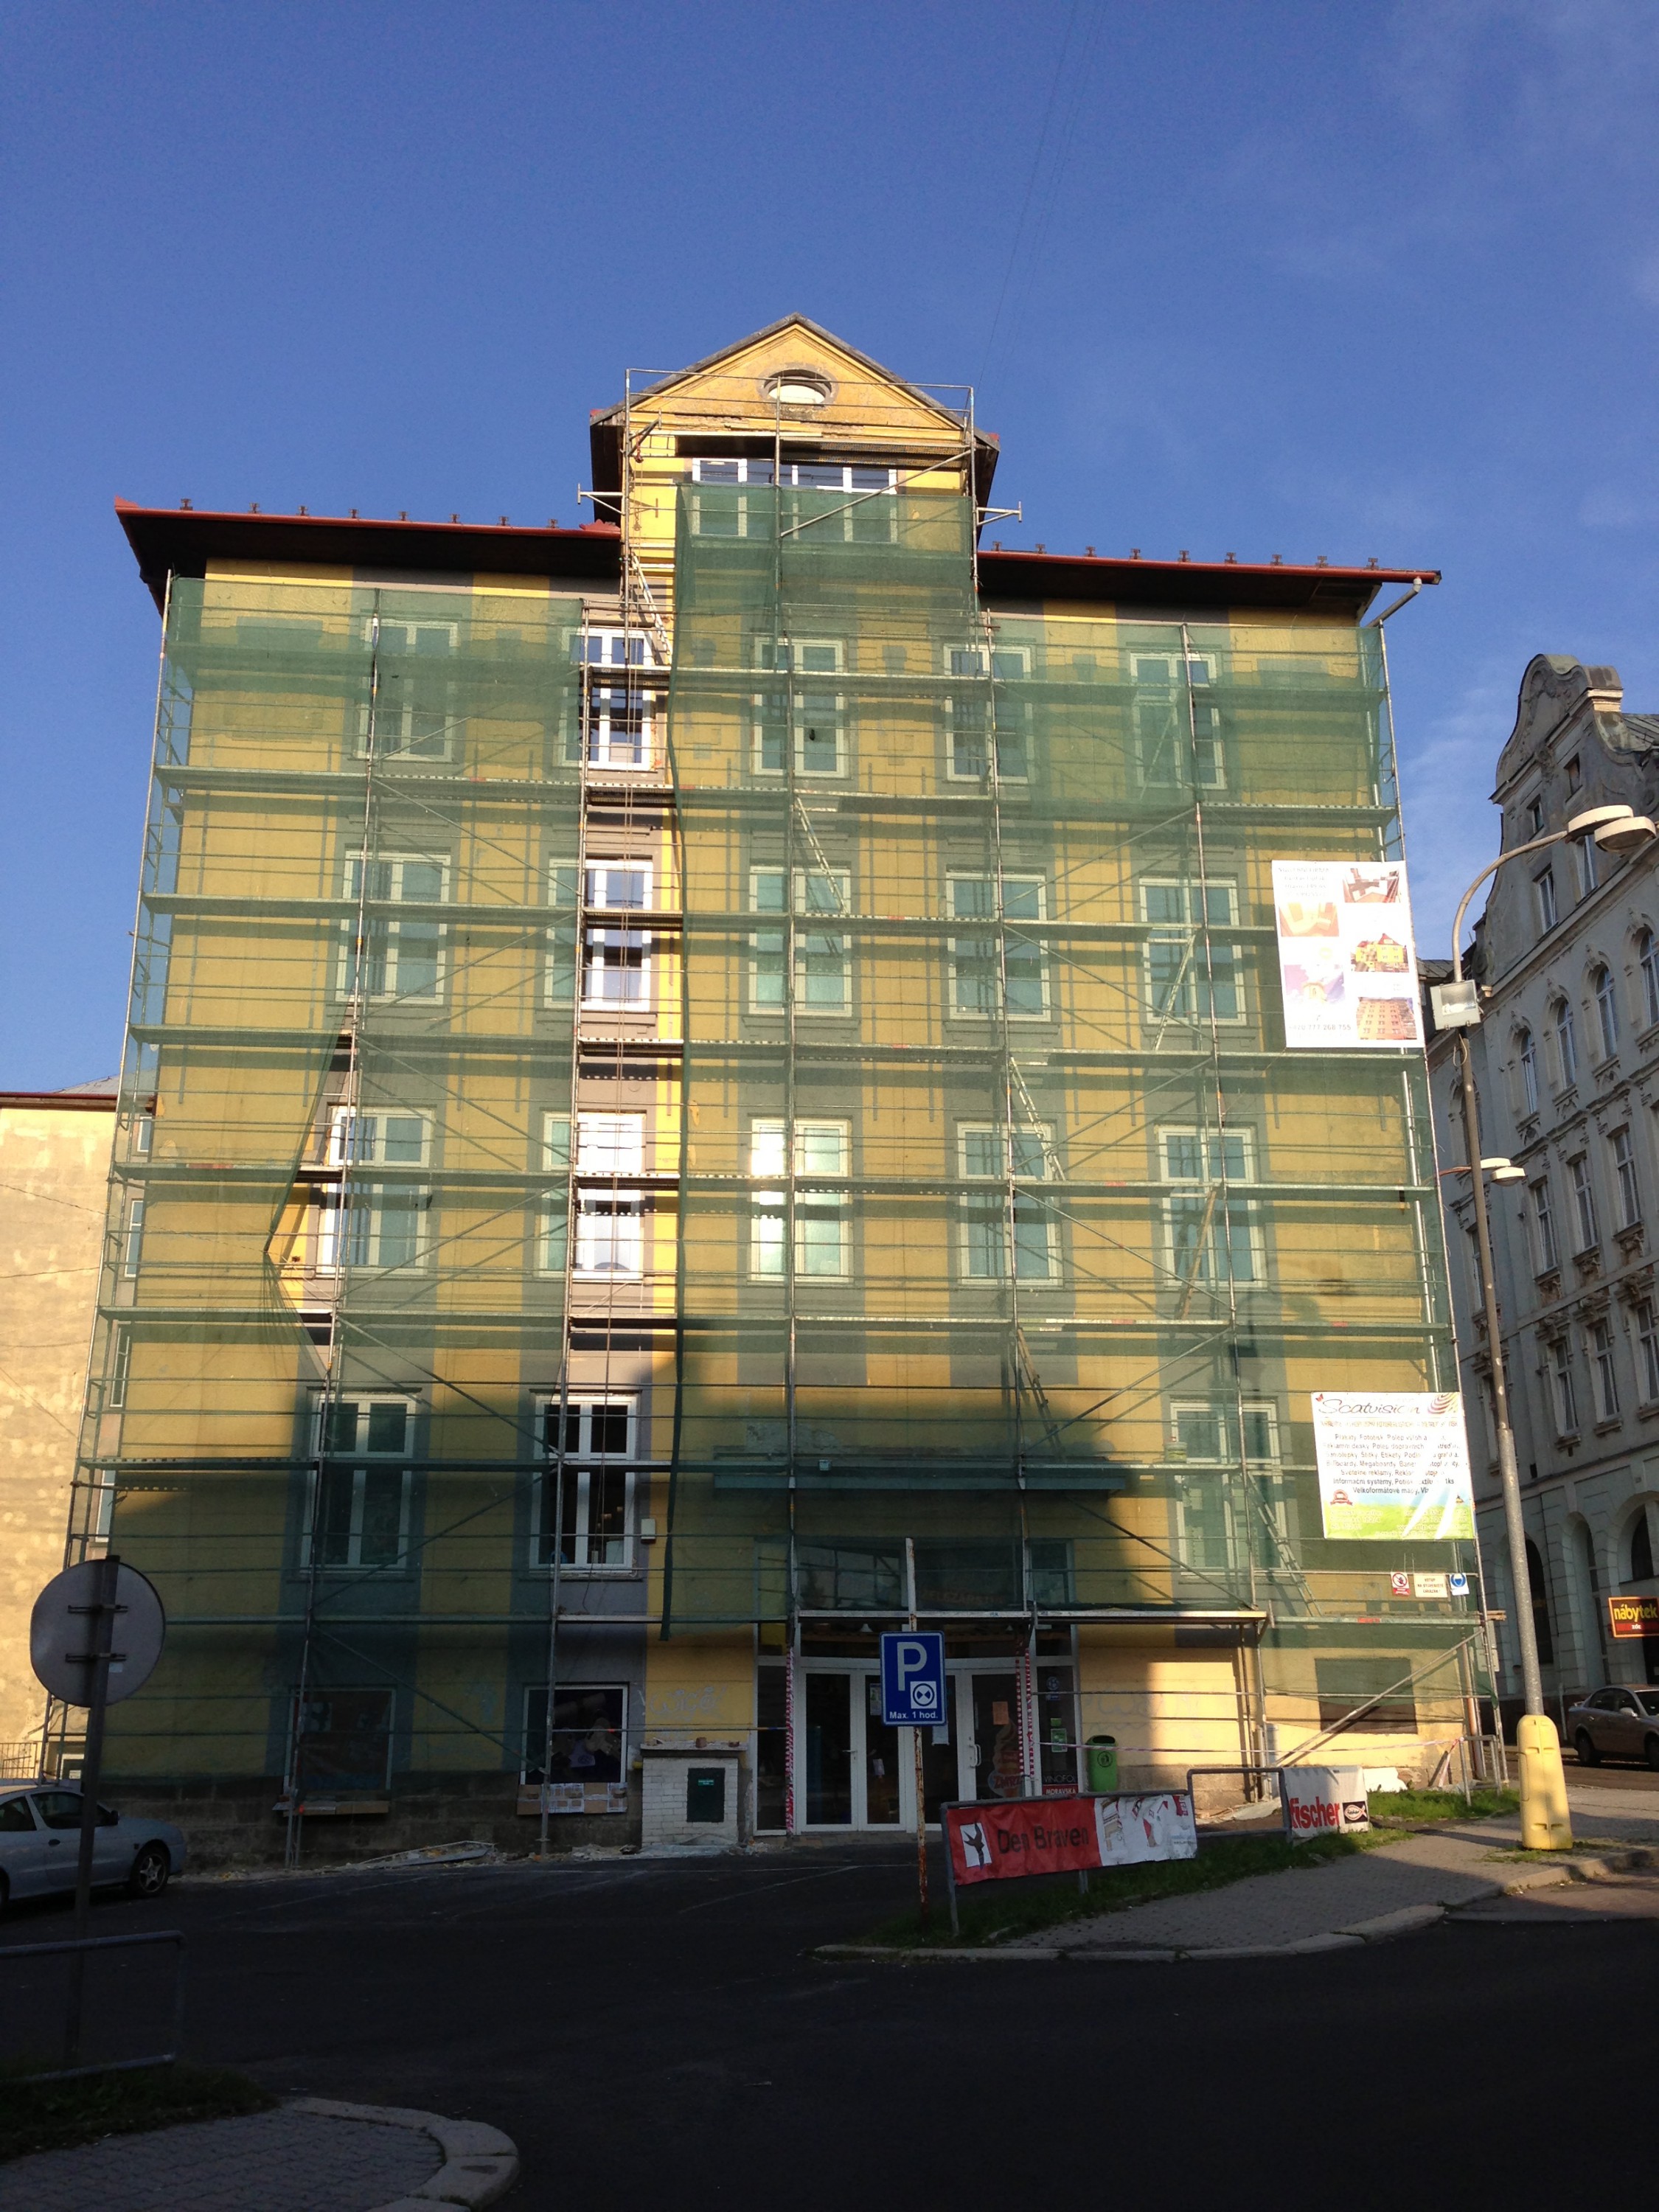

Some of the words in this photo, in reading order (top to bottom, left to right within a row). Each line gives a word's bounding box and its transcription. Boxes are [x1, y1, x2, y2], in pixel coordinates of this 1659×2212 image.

[1613, 1603, 1658, 1623] nábytek
[897, 1642, 928, 1691] P
[919, 1711, 938, 1719] hod.
[1290, 1796, 1340, 1829] fischer
[997, 1829, 1030, 1854] Den
[1034, 1825, 1088, 1850] Braven
